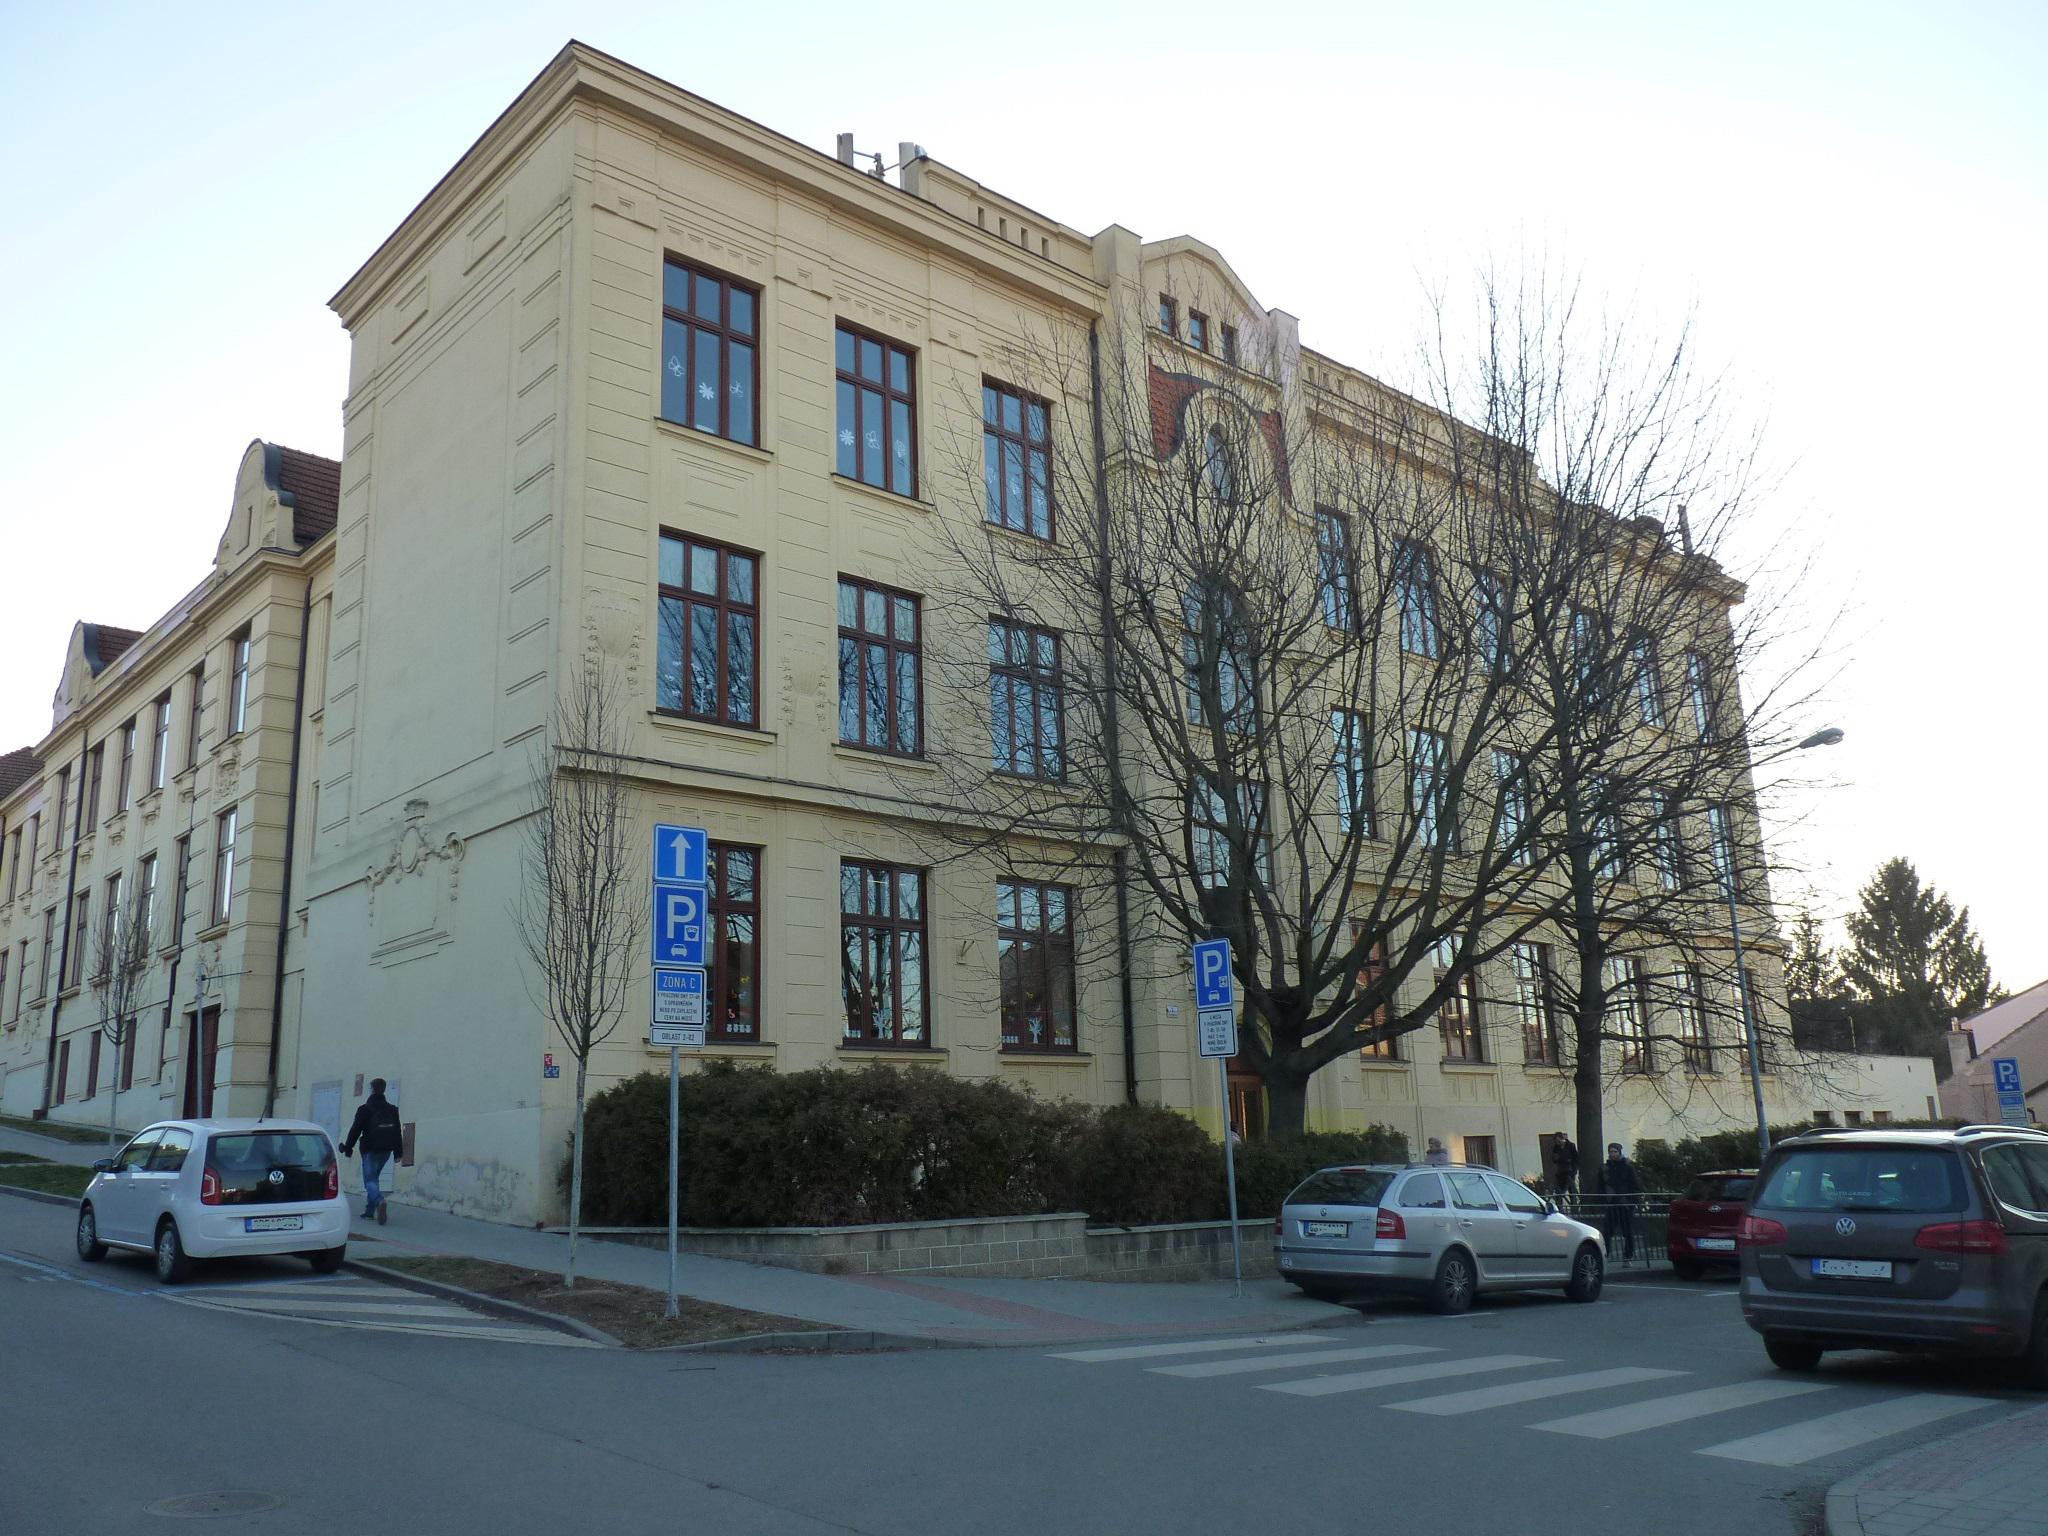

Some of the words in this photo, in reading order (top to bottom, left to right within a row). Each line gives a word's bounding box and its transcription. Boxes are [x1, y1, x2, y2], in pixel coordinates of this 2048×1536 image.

[667, 894, 697, 939] P
[1202, 949, 1223, 987] P
[663, 975, 687, 989] ZONA
[690, 978, 696, 989] C
[662, 1032, 680, 1040] OBLAST
[1998, 1062, 2014, 1083] P
